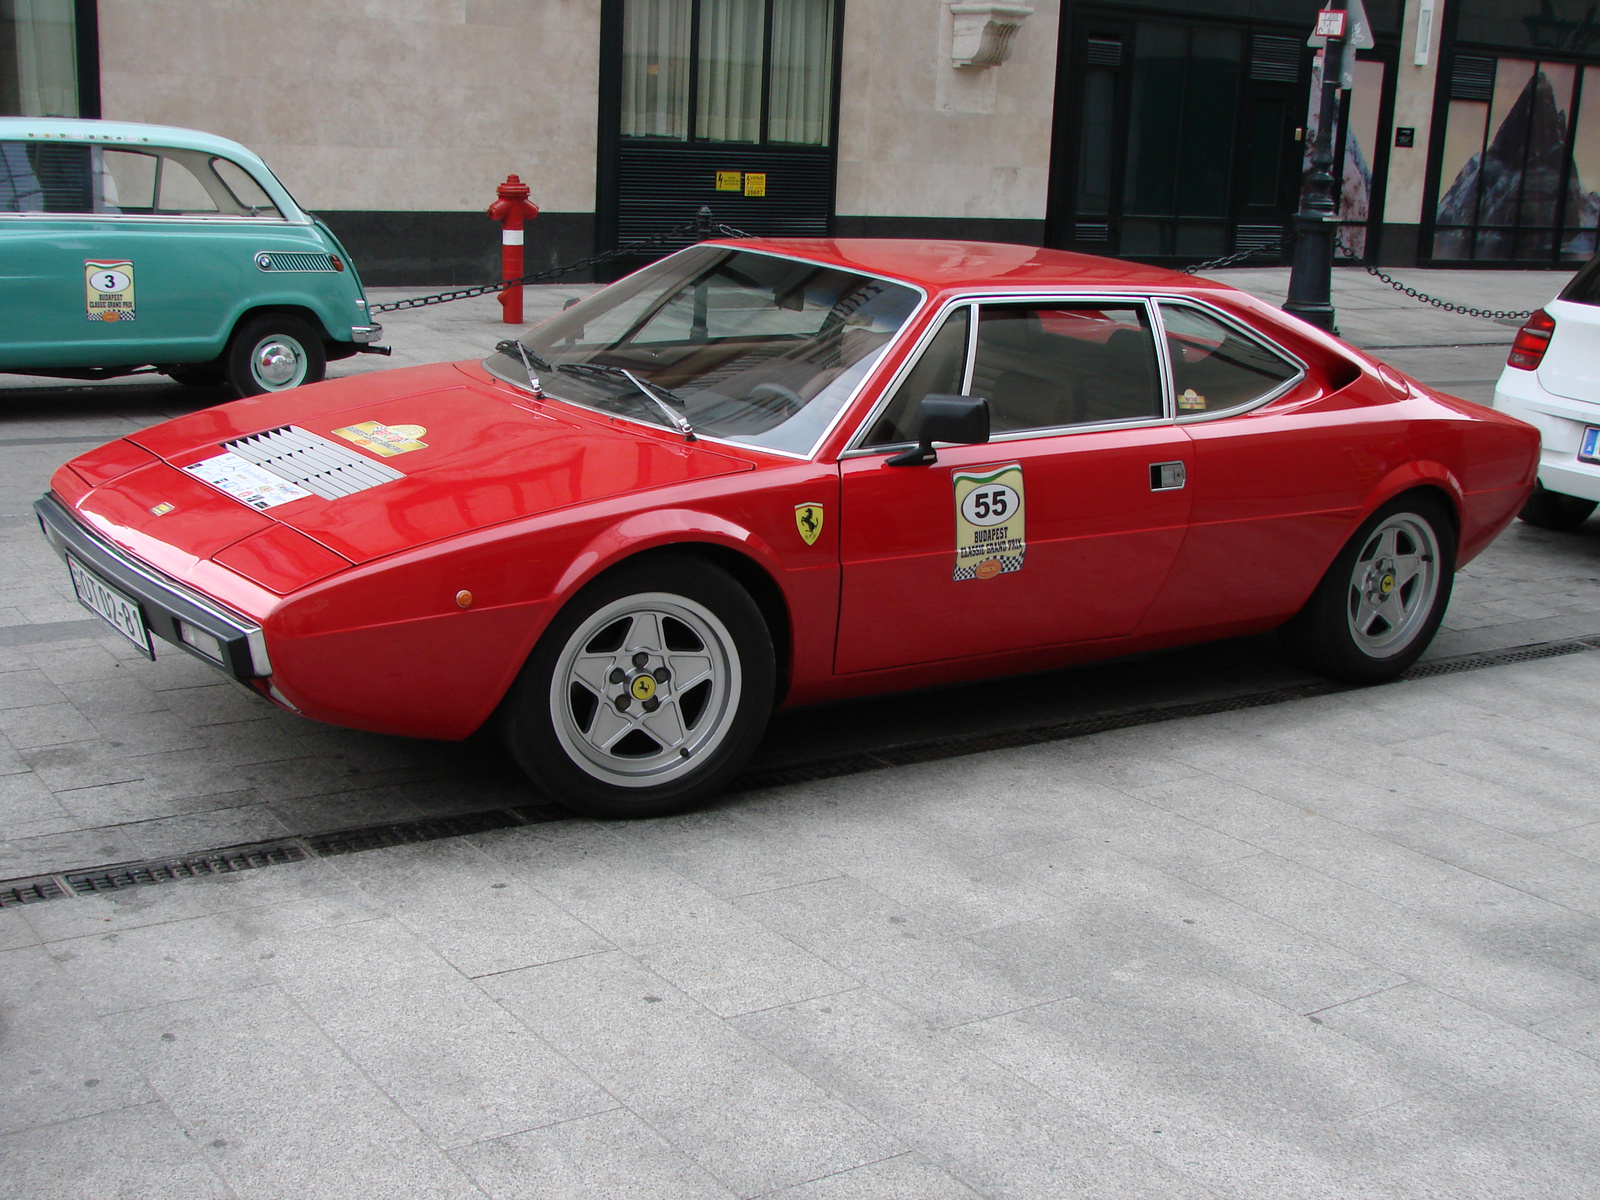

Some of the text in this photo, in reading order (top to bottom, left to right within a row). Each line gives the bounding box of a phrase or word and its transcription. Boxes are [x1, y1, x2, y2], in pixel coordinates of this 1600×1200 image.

[104, 275, 116, 288] 3
[974, 490, 1008, 519] 55
[974, 527, 1009, 543] BUDAPEST
[960, 538, 1023, 558] CLASSIC GRAND PRIX
